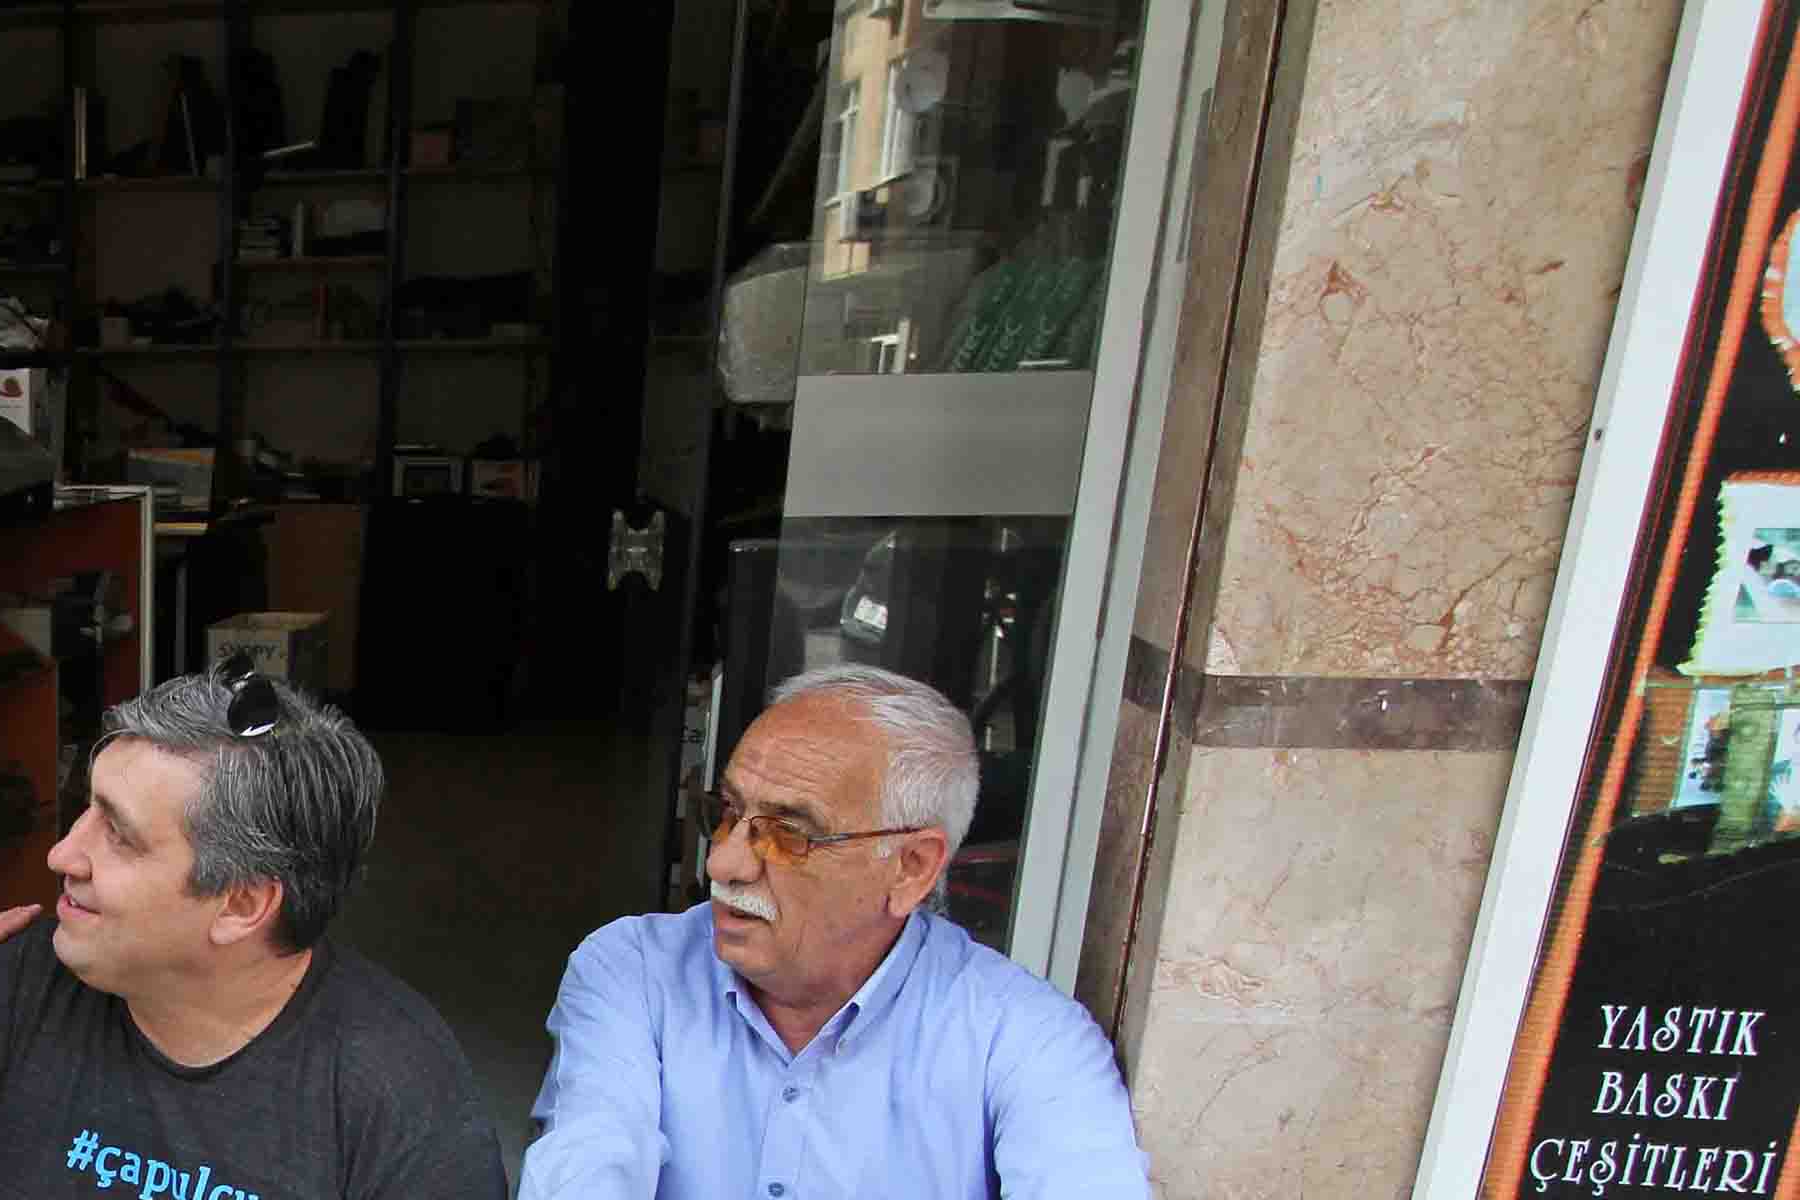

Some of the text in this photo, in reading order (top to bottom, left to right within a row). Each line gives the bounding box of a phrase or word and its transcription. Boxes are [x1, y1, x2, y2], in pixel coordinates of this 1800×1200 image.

[1597, 1004, 1766, 1056] YASTIK
[1592, 1071, 1737, 1121] BASKI
[1530, 1132, 1778, 1197] ÇEŞİTLERİ
